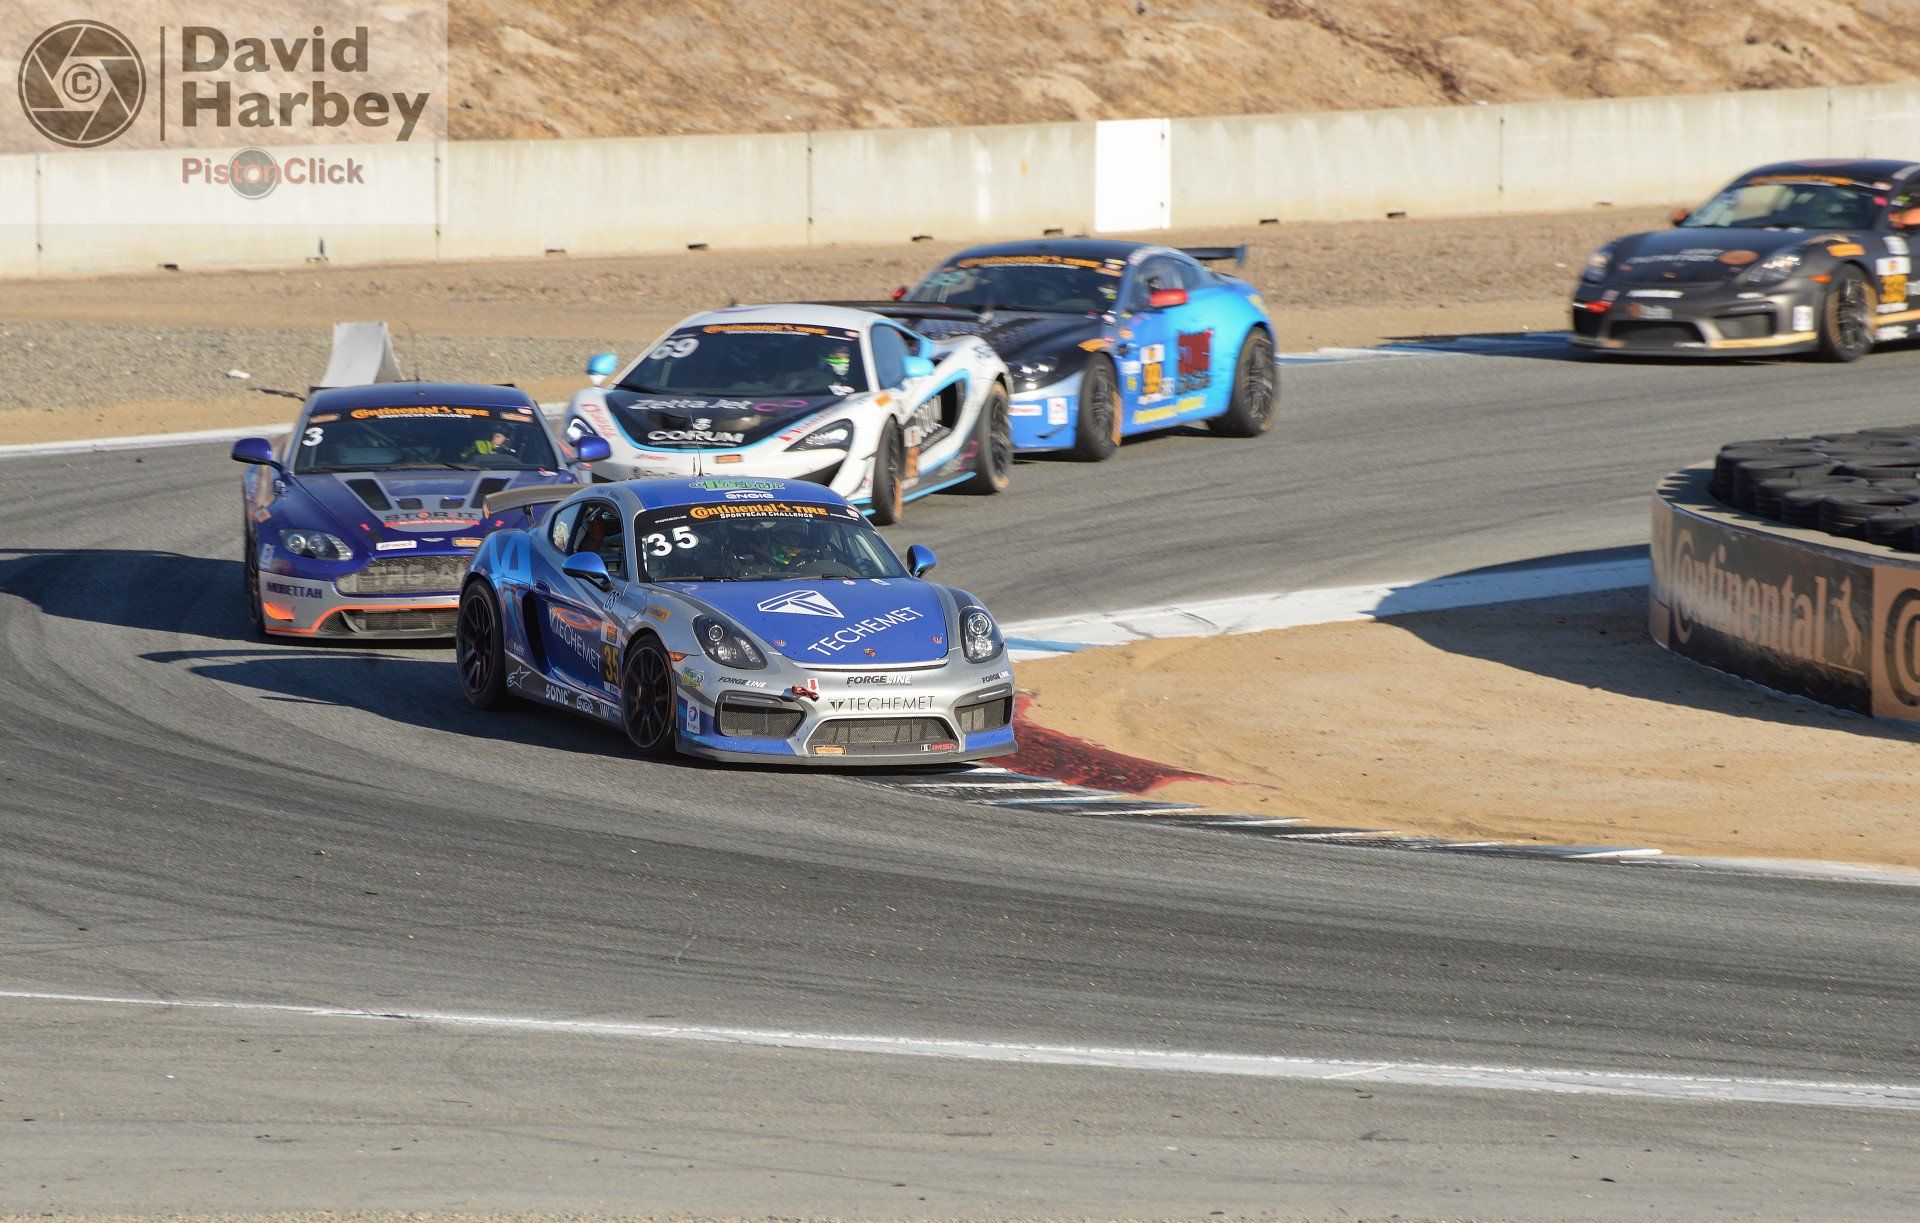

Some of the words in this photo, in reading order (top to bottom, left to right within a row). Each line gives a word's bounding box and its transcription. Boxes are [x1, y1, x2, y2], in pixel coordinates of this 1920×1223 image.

[648, 338, 700, 360] 69
[350, 406, 440, 419] Continental
[301, 427, 324, 447] 3
[647, 430, 745, 443] CORUM
[689, 503, 779, 519] Continental
[791, 505, 829, 516] TIRE
[720, 511, 767, 519] SPORTSCAR
[768, 511, 814, 519] CHALLENGE
[647, 525, 699, 557] 35
[1673, 529, 1828, 664] Continental
[807, 606, 925, 656] TECHEMET
[556, 615, 601, 673] TECHEMET
[717, 676, 768, 688] FORGELINE
[846, 675, 913, 685] FORGELINE
[981, 670, 1011, 684] FORGELINE
[848, 695, 936, 711] TECHEMET
[932, 742, 957, 751] IMSA
